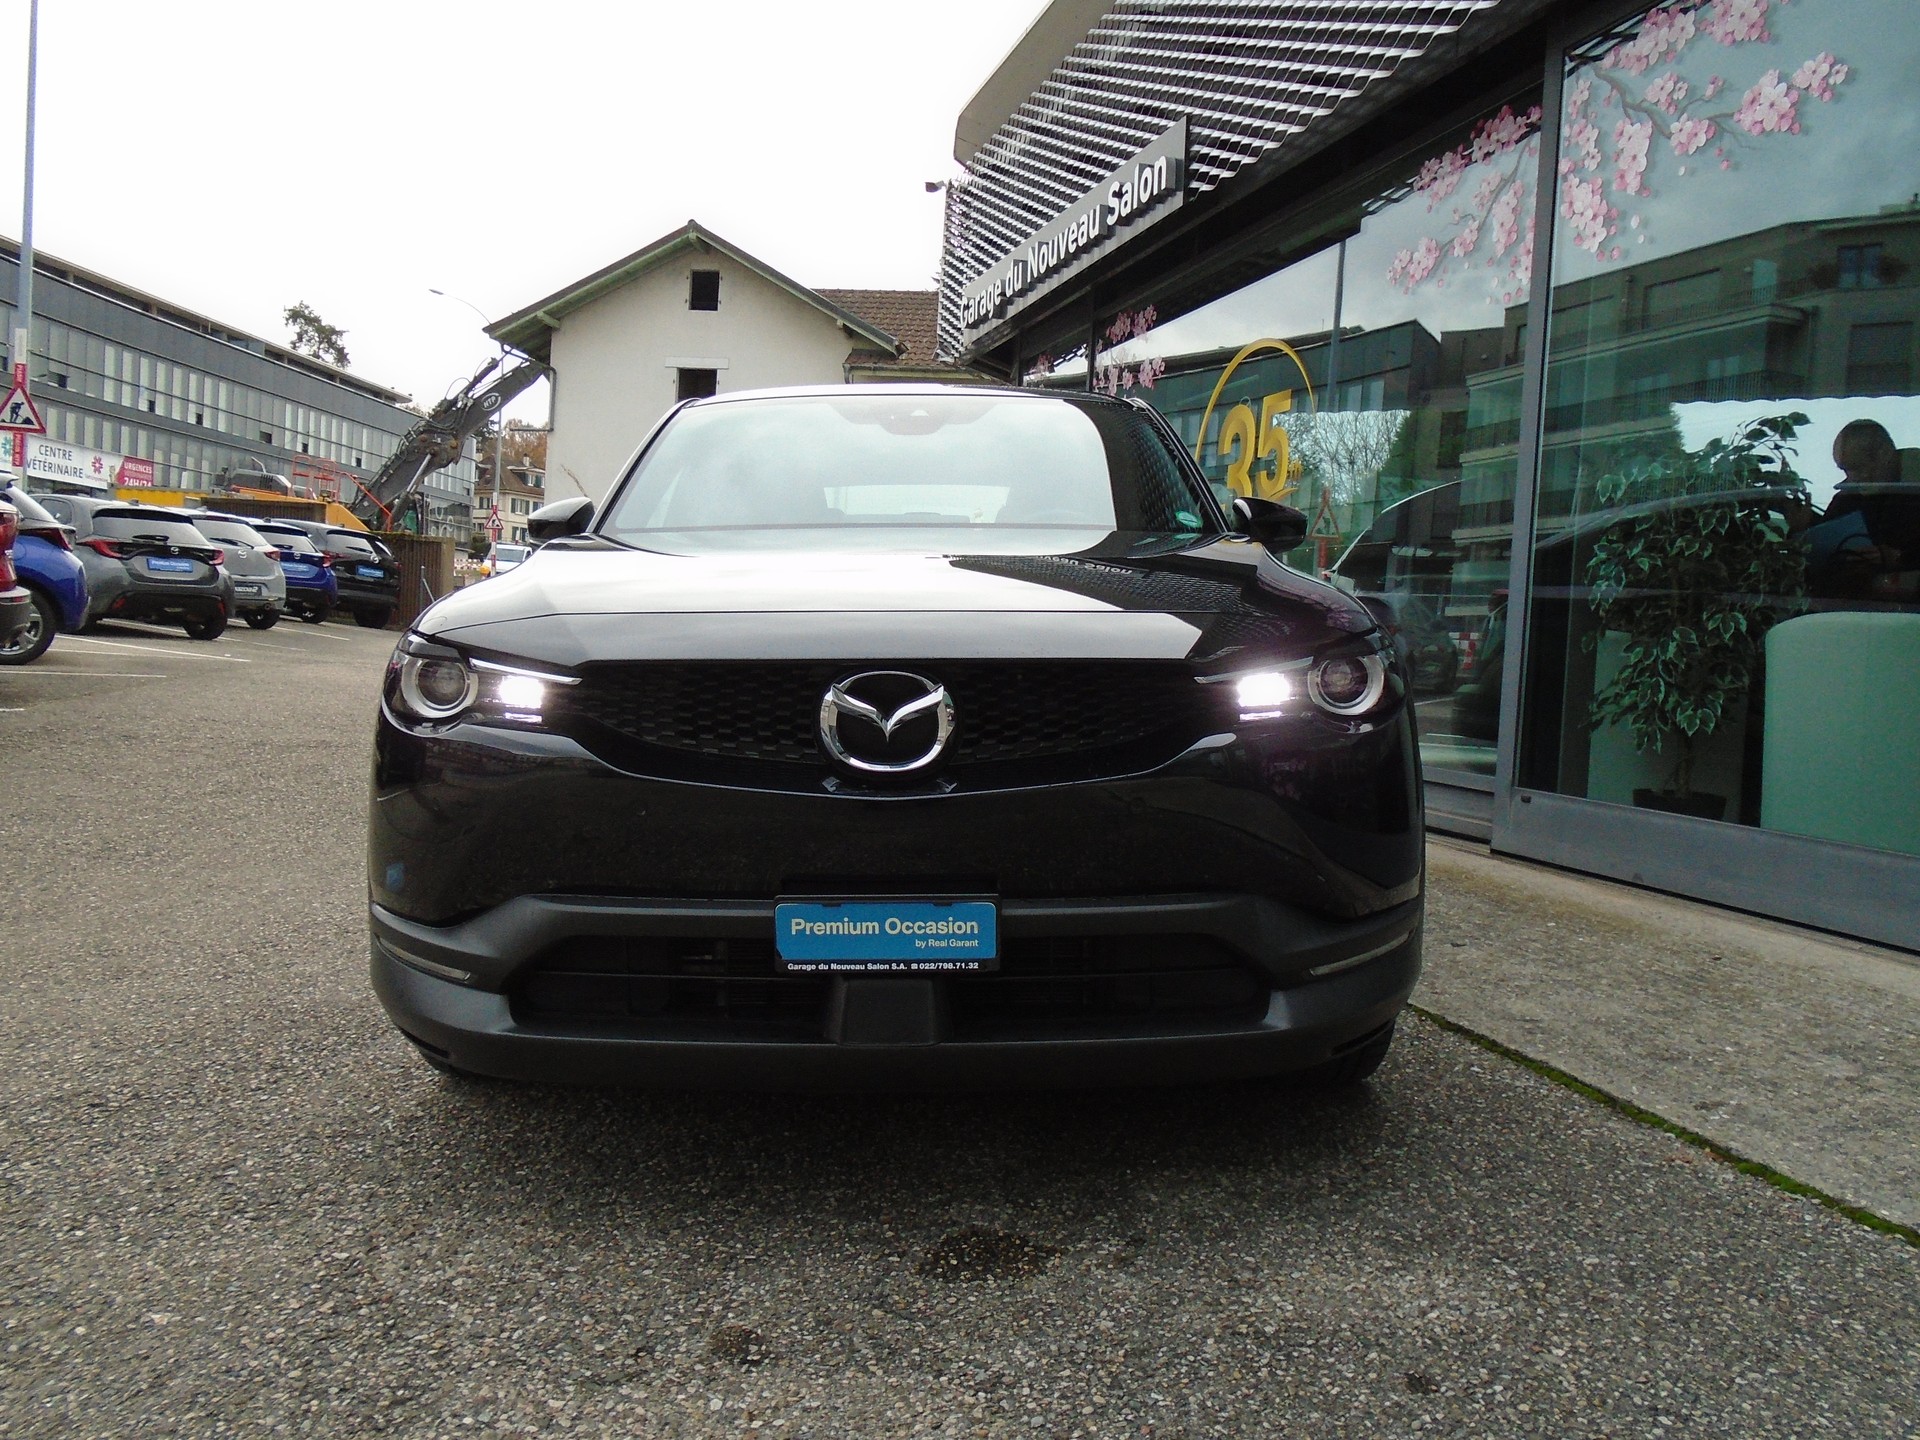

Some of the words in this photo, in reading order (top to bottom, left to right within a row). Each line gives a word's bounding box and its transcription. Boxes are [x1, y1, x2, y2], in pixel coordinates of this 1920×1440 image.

[959, 278, 1003, 328] Garage
[1005, 259, 1024, 298] du
[1026, 204, 1101, 284] Nouveau
[1106, 154, 1168, 227] Salon
[38, 444, 73, 462] CENTRE
[26, 456, 84, 479] VÉTÉRINAIRE
[124, 461, 152, 474] URGENCES
[790, 917, 880, 936] Premium
[884, 916, 979, 936] Occasion
[915, 939, 926, 949] by
[928, 938, 948, 948] Real
[949, 938, 979, 948] Garant
[787, 962, 817, 972] Garage
[818, 962, 829, 971] du
[830, 962, 866, 971] Nouveau
[866, 962, 890, 971] Salon
[891, 962, 908, 971] S.A.
